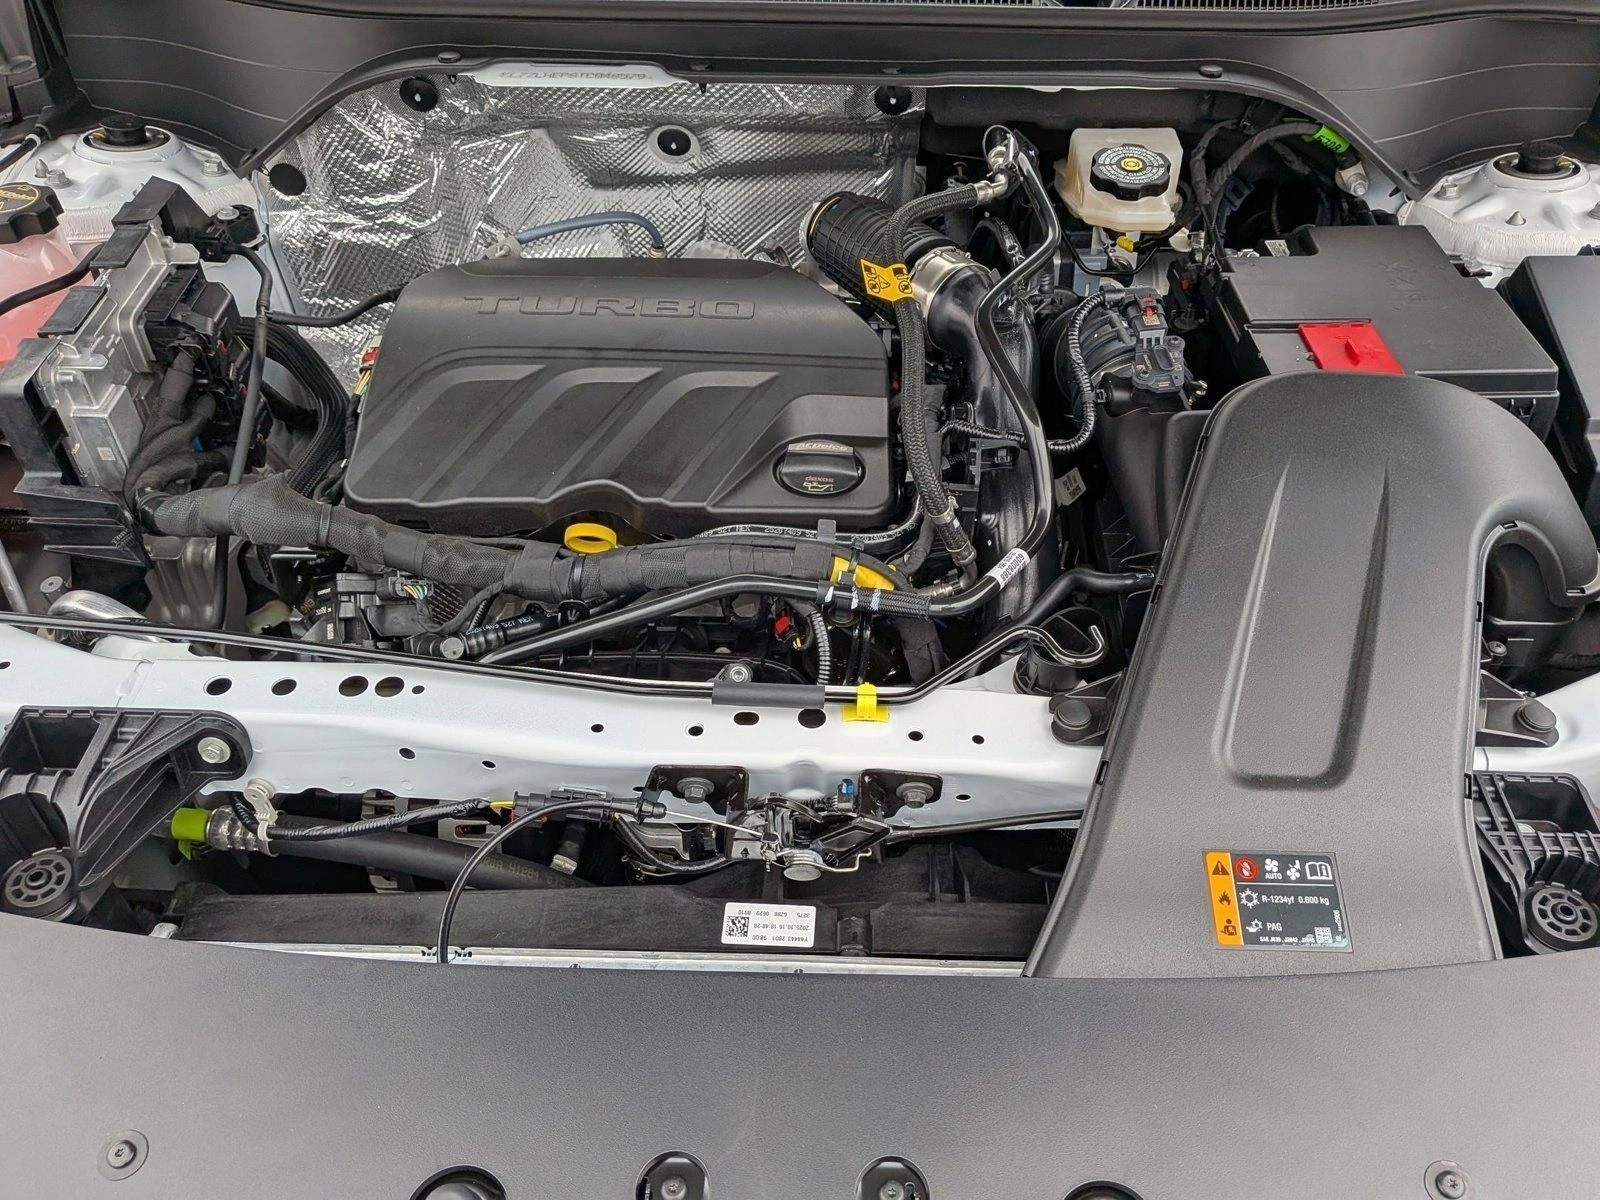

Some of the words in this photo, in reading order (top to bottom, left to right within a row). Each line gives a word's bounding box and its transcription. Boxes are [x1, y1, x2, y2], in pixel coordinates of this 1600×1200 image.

[463, 296, 756, 321] TURBO
[805, 475, 834, 483] dexos
[1265, 872, 1283, 880] AUTO
[1261, 894, 1295, 905] R-1234yf
[1320, 896, 1330, 906] kg
[1266, 922, 1283, 932] PAG
